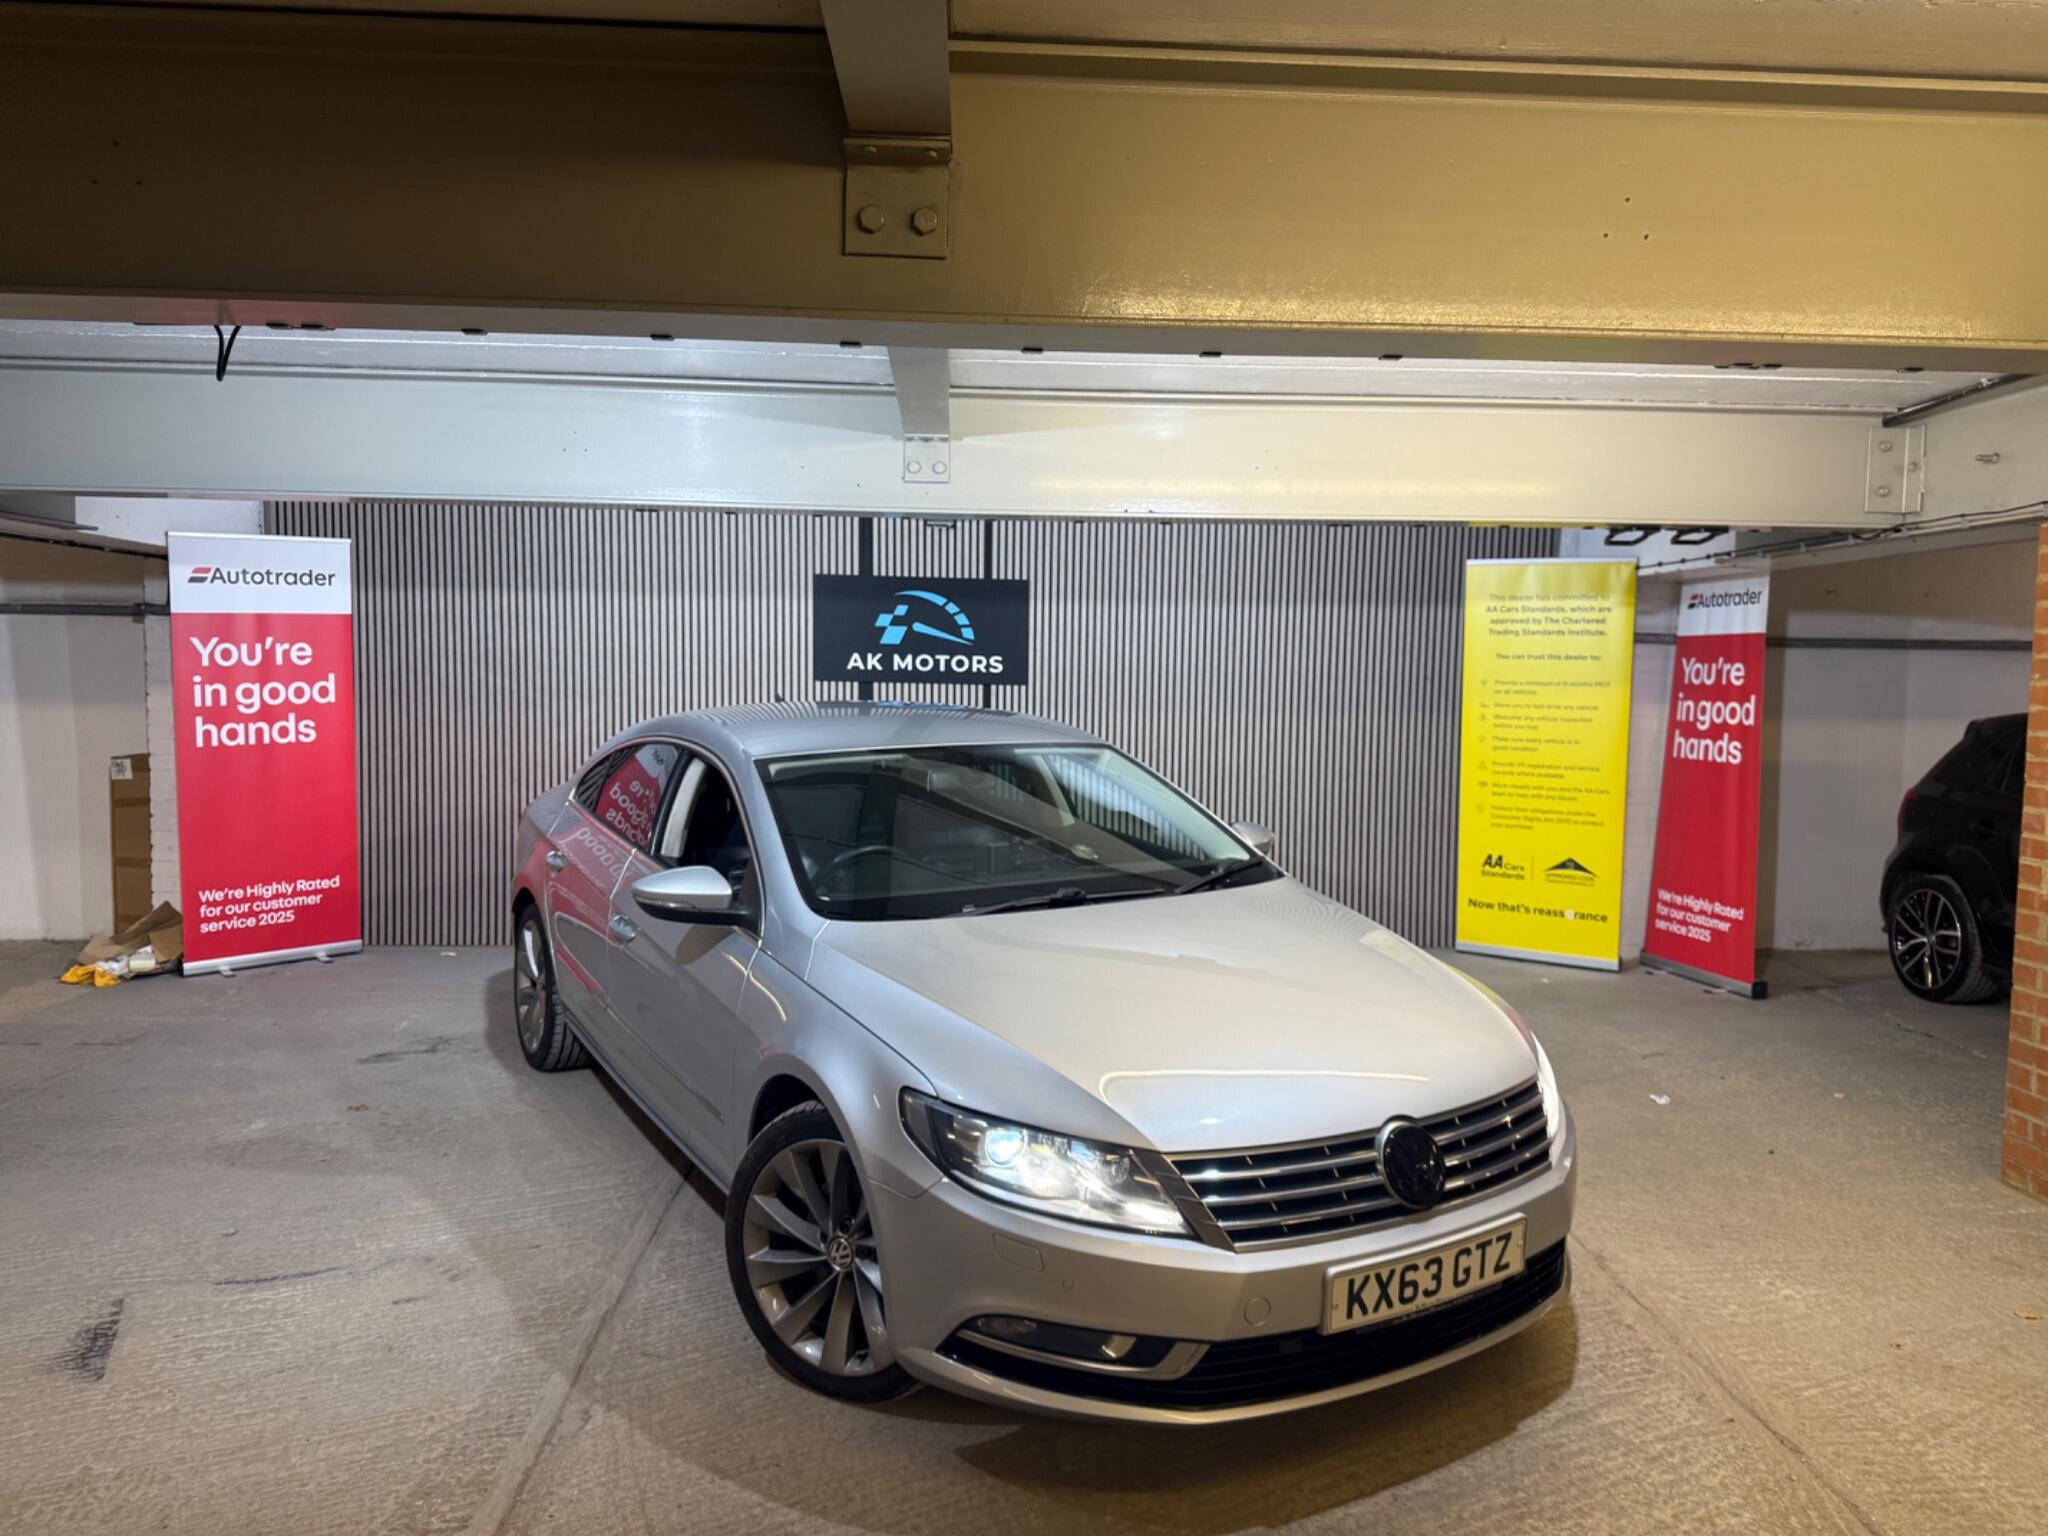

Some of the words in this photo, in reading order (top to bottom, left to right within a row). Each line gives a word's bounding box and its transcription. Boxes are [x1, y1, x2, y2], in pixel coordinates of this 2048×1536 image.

[210, 567, 336, 587] Autotrader
[1500, 605, 1519, 613] Cars
[1570, 605, 1595, 613] which
[1697, 590, 1762, 609] Autotrader
[1489, 628, 1519, 637] Trading
[1522, 628, 1565, 636] Standards
[1490, 617, 1529, 626] approved
[1532, 617, 1542, 626] by
[1562, 617, 1606, 625] Chartered
[189, 636, 313, 668] You're
[846, 652, 883, 671] AK
[893, 653, 1004, 674] MOTORS
[1681, 657, 1745, 686] You're
[192, 674, 227, 708] in
[235, 672, 336, 715] good
[1676, 691, 1694, 722] in
[1696, 694, 1756, 731] good
[195, 712, 317, 749] hands
[1673, 729, 1742, 765] hands
[1482, 854, 1503, 869] AA
[1504, 863, 1525, 871] Cars
[1481, 870, 1525, 880] Standards
[198, 887, 244, 904] We're
[246, 881, 294, 899] Highly
[296, 874, 340, 892] Rated
[200, 904, 222, 918] for
[224, 902, 250, 915] our
[252, 893, 323, 912] customer
[1468, 898, 1494, 910] Now
[1498, 902, 1530, 914] that's
[1657, 888, 1682, 906] We're
[1683, 894, 1713, 915] Highly
[1713, 901, 1744, 921] Rated
[200, 916, 256, 933] service
[258, 910, 295, 926] 2025
[1656, 902, 1668, 915] for
[1669, 908, 1685, 920] our
[1686, 912, 1731, 933] customer
[1345, 1256, 1444, 1321] KX63
[1453, 1231, 1513, 1289] GTZ
